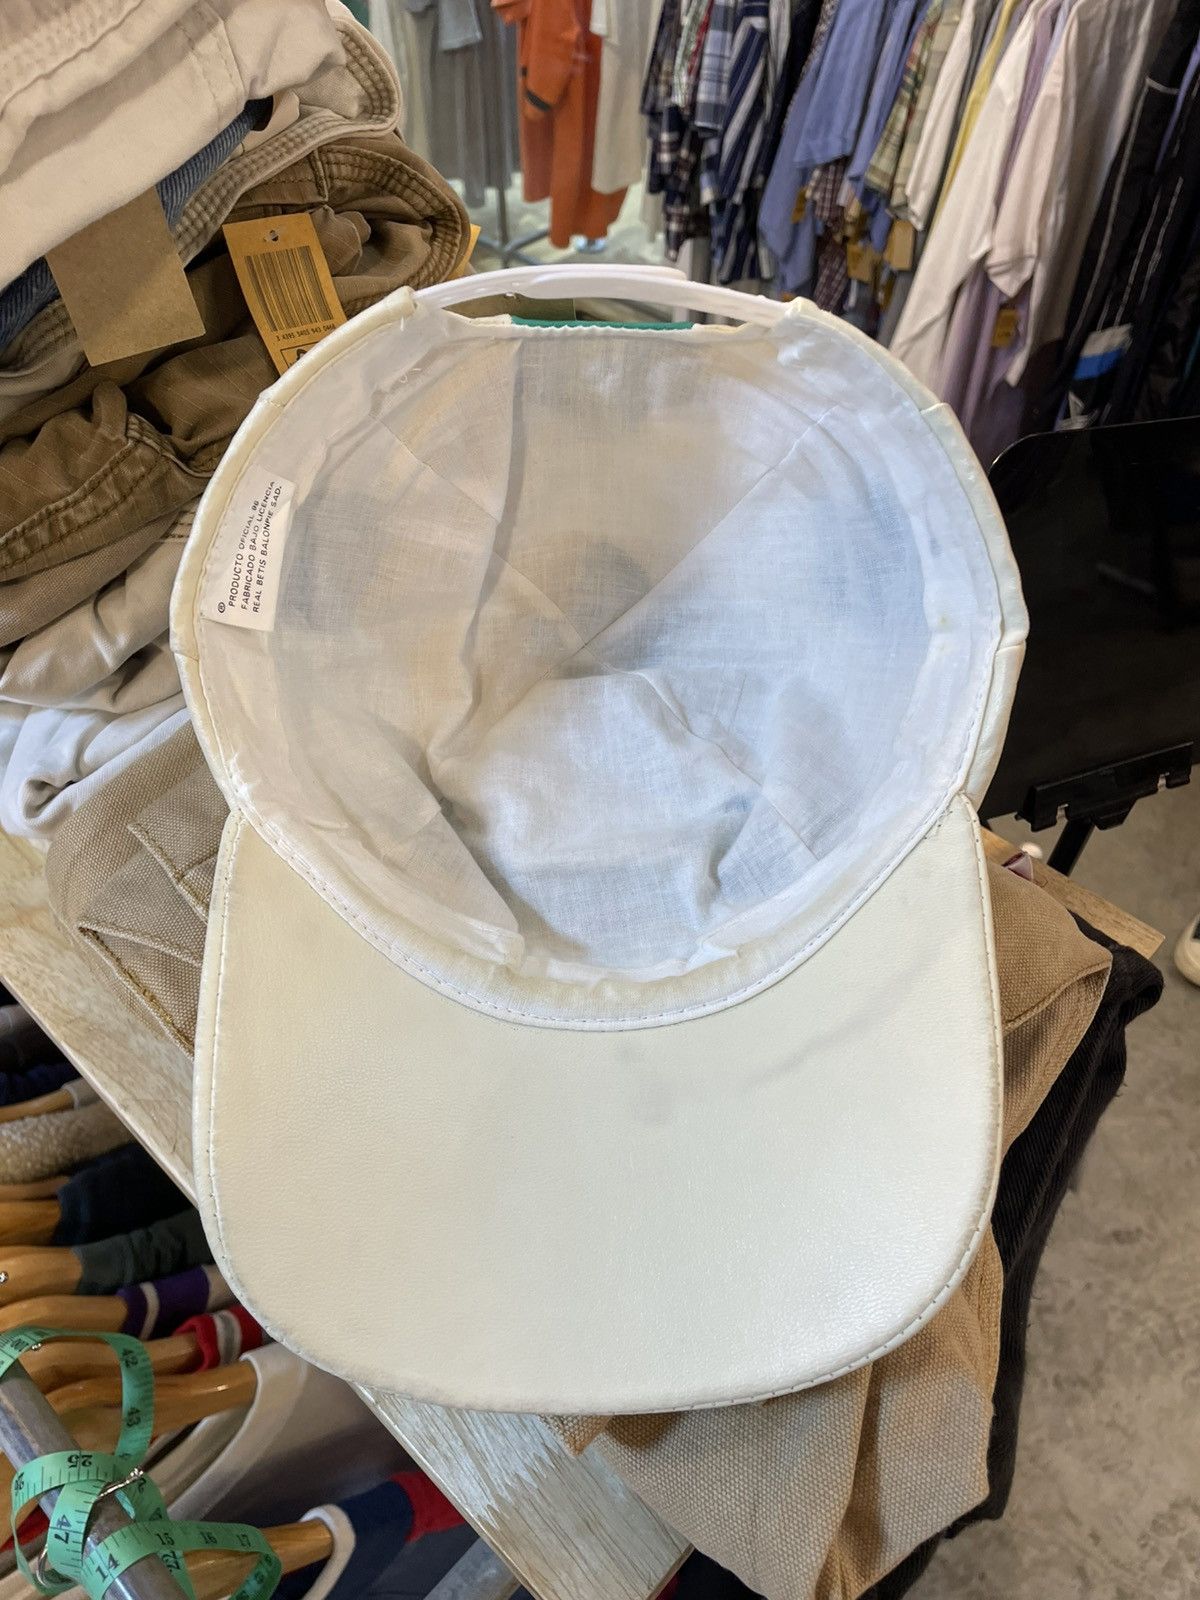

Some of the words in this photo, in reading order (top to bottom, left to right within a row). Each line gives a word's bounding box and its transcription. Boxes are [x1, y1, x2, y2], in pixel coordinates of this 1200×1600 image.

[270, 485, 283, 509] SAD.
[240, 554, 256, 610] FABRICADO
[249, 525, 260, 552] BAJO
[256, 481, 276, 522] LICENCIA
[261, 510, 275, 556] BALONPIE
[228, 553, 244, 607] PRODUCTO
[238, 514, 255, 550] OFICIAL
[256, 559, 267, 586] BETIS
[252, 590, 263, 613] REAL
[67, 1454, 93, 1468] 25
[54, 1514, 72, 1544] 47
[155, 1532, 175, 1546] 15
[199, 1531, 218, 1545] 16
[236, 1533, 252, 1549] 17
[95, 1553, 120, 1581] 14
